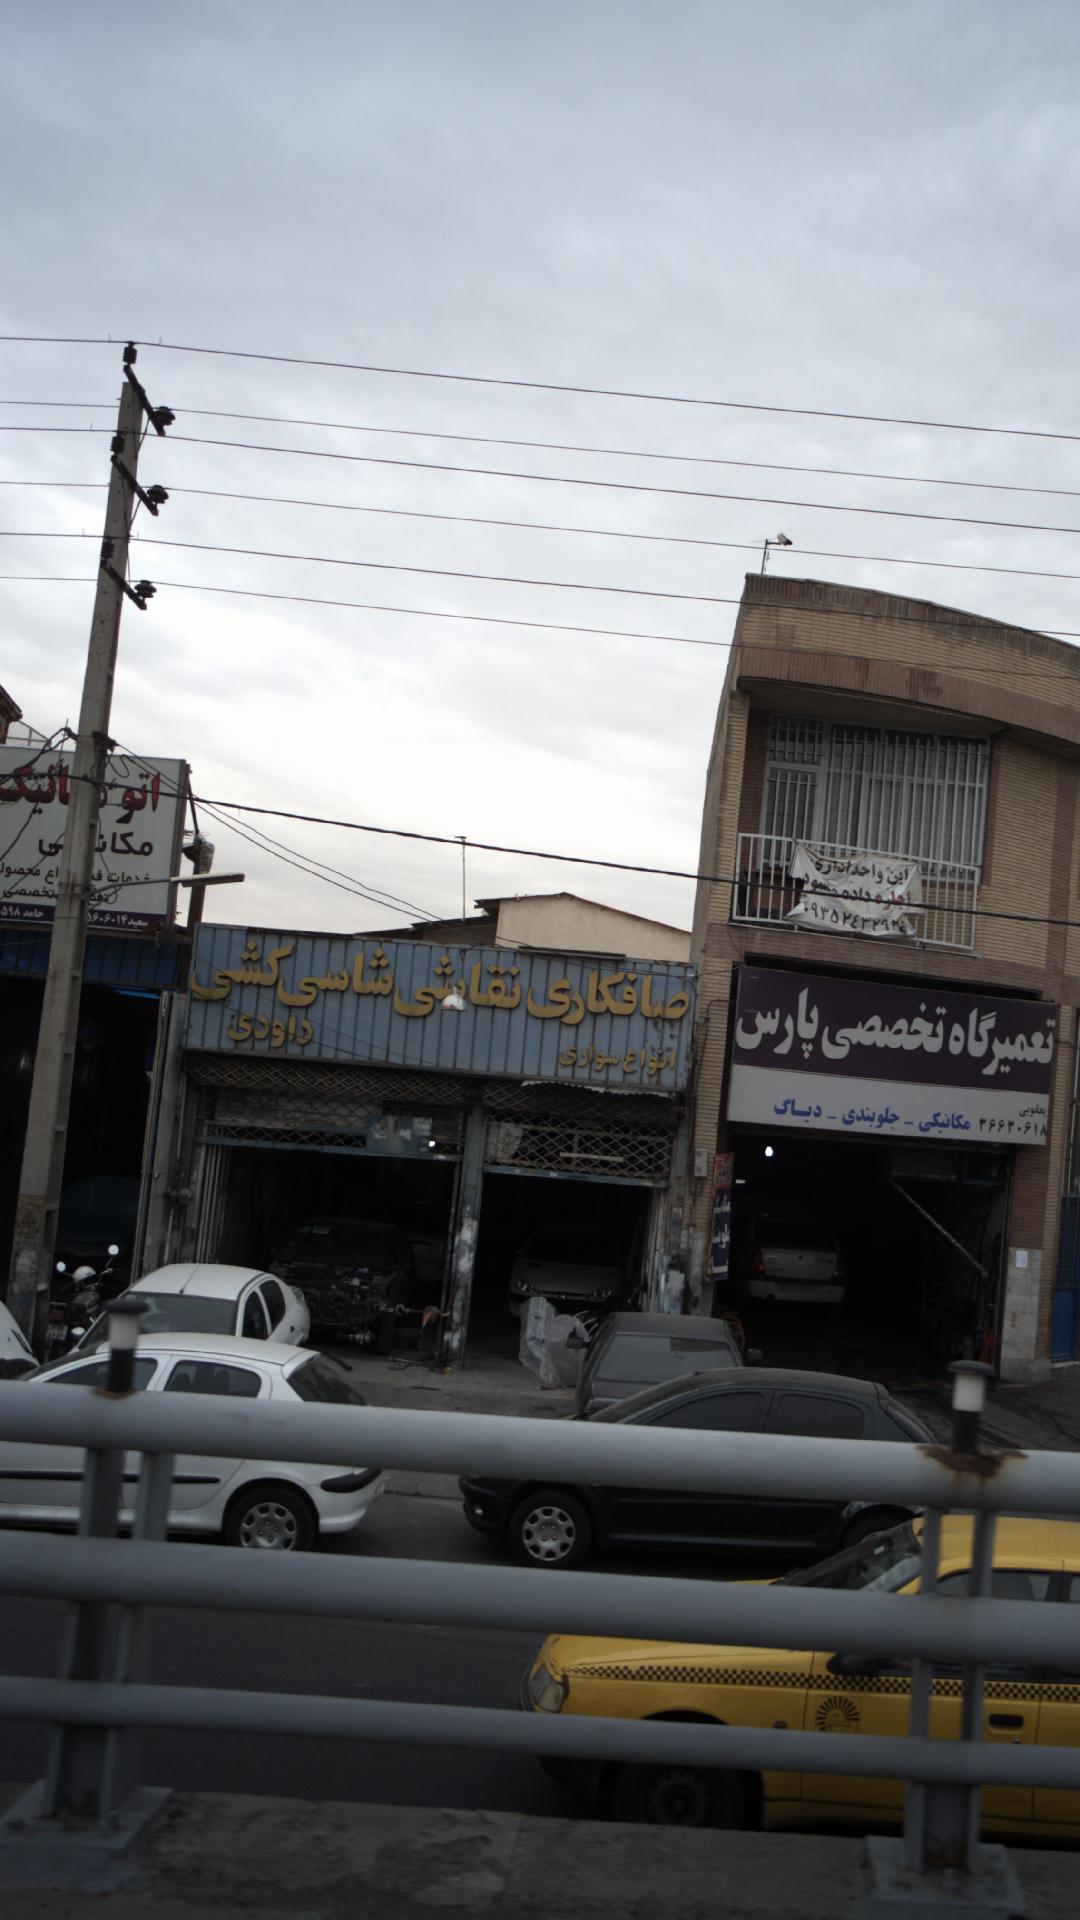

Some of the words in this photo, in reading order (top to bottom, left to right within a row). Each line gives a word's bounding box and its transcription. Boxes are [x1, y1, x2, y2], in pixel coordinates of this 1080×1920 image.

[39, 832, 153, 857] مکانی
[188, 938, 296, 1000] کشی
[277, 947, 394, 1008] شاسی
[393, 954, 521, 1018] نقاشی
[526, 971, 690, 1025] صافکاری
[227, 1011, 313, 1048] داودی
[735, 987, 820, 1060] پارس
[821, 1001, 946, 1060] تخصصی
[948, 1007, 1056, 1076] تعمیرگاه
[560, 1041, 620, 1072] سواری
[622, 1044, 677, 1076] انواع
[774, 1098, 822, 1123] دیاگ
[842, 1106, 900, 1130] جلوبندی
[918, 1111, 971, 1133] مکانیکی
